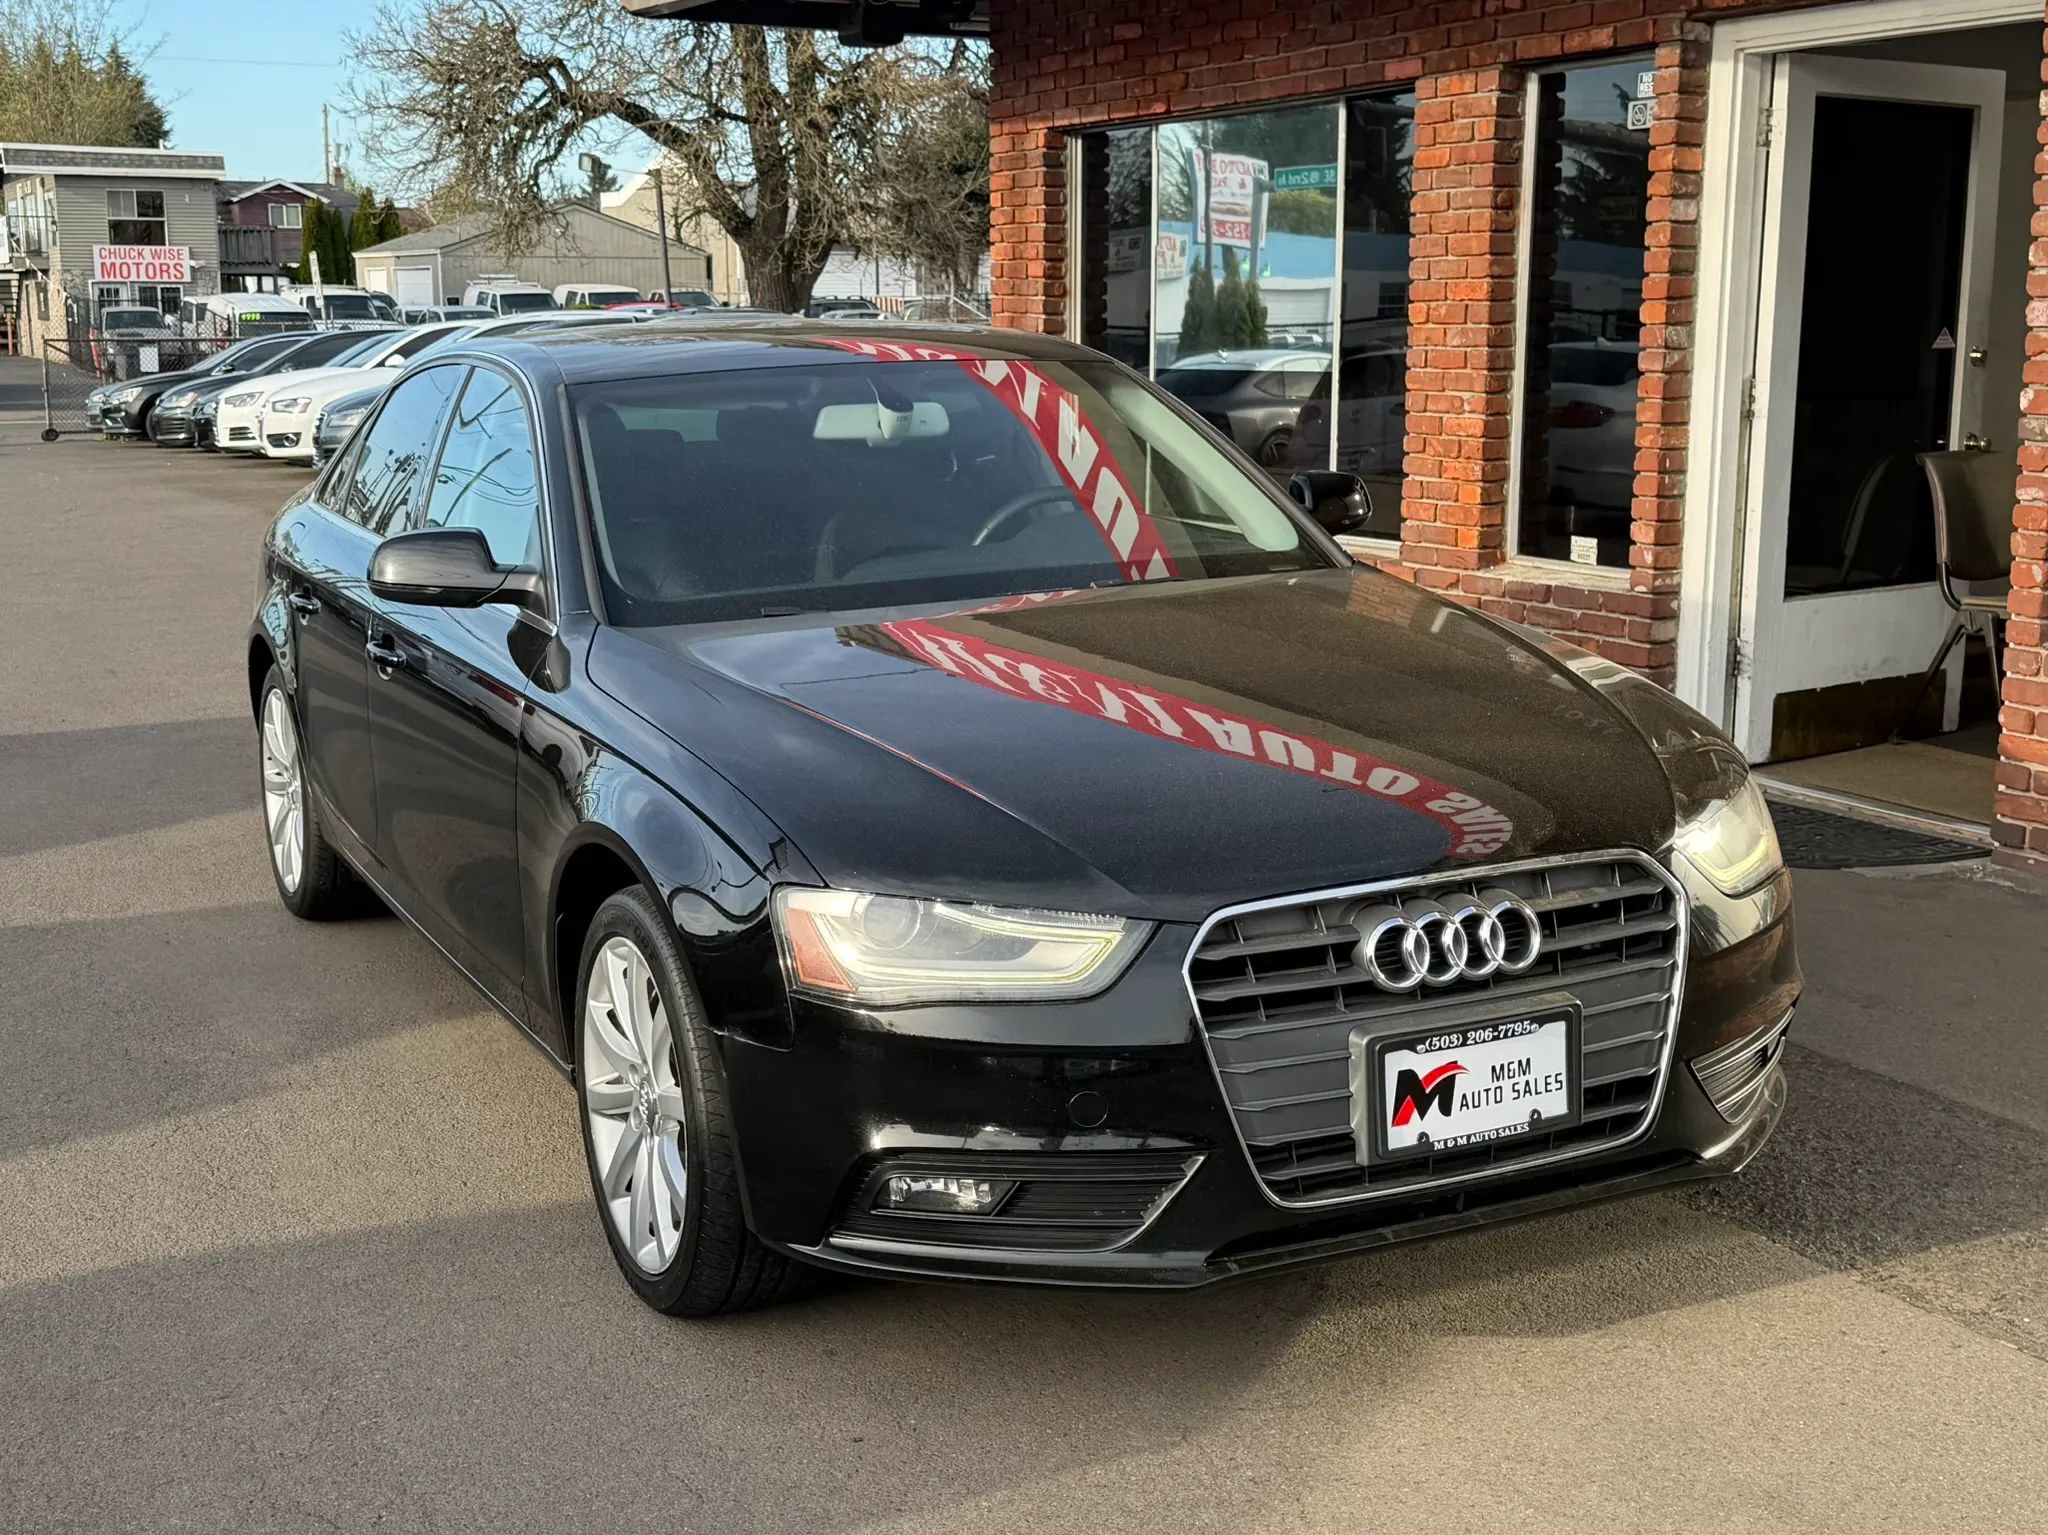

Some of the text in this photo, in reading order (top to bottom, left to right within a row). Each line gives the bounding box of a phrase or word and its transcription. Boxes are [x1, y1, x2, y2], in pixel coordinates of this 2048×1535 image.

[99, 247, 184, 261] CHUCK WISE
[100, 261, 185, 280] MOTORS
[1425, 1020, 1532, 1051] (503) 206-7795
[1490, 1057, 1532, 1083] M&M
[1459, 1073, 1563, 1112] AUTO SALES
[1433, 1140, 1446, 1150] M
[1456, 1136, 1468, 1146] M
[1469, 1131, 1497, 1144] AUTO
[1498, 1123, 1530, 1138] SALES
